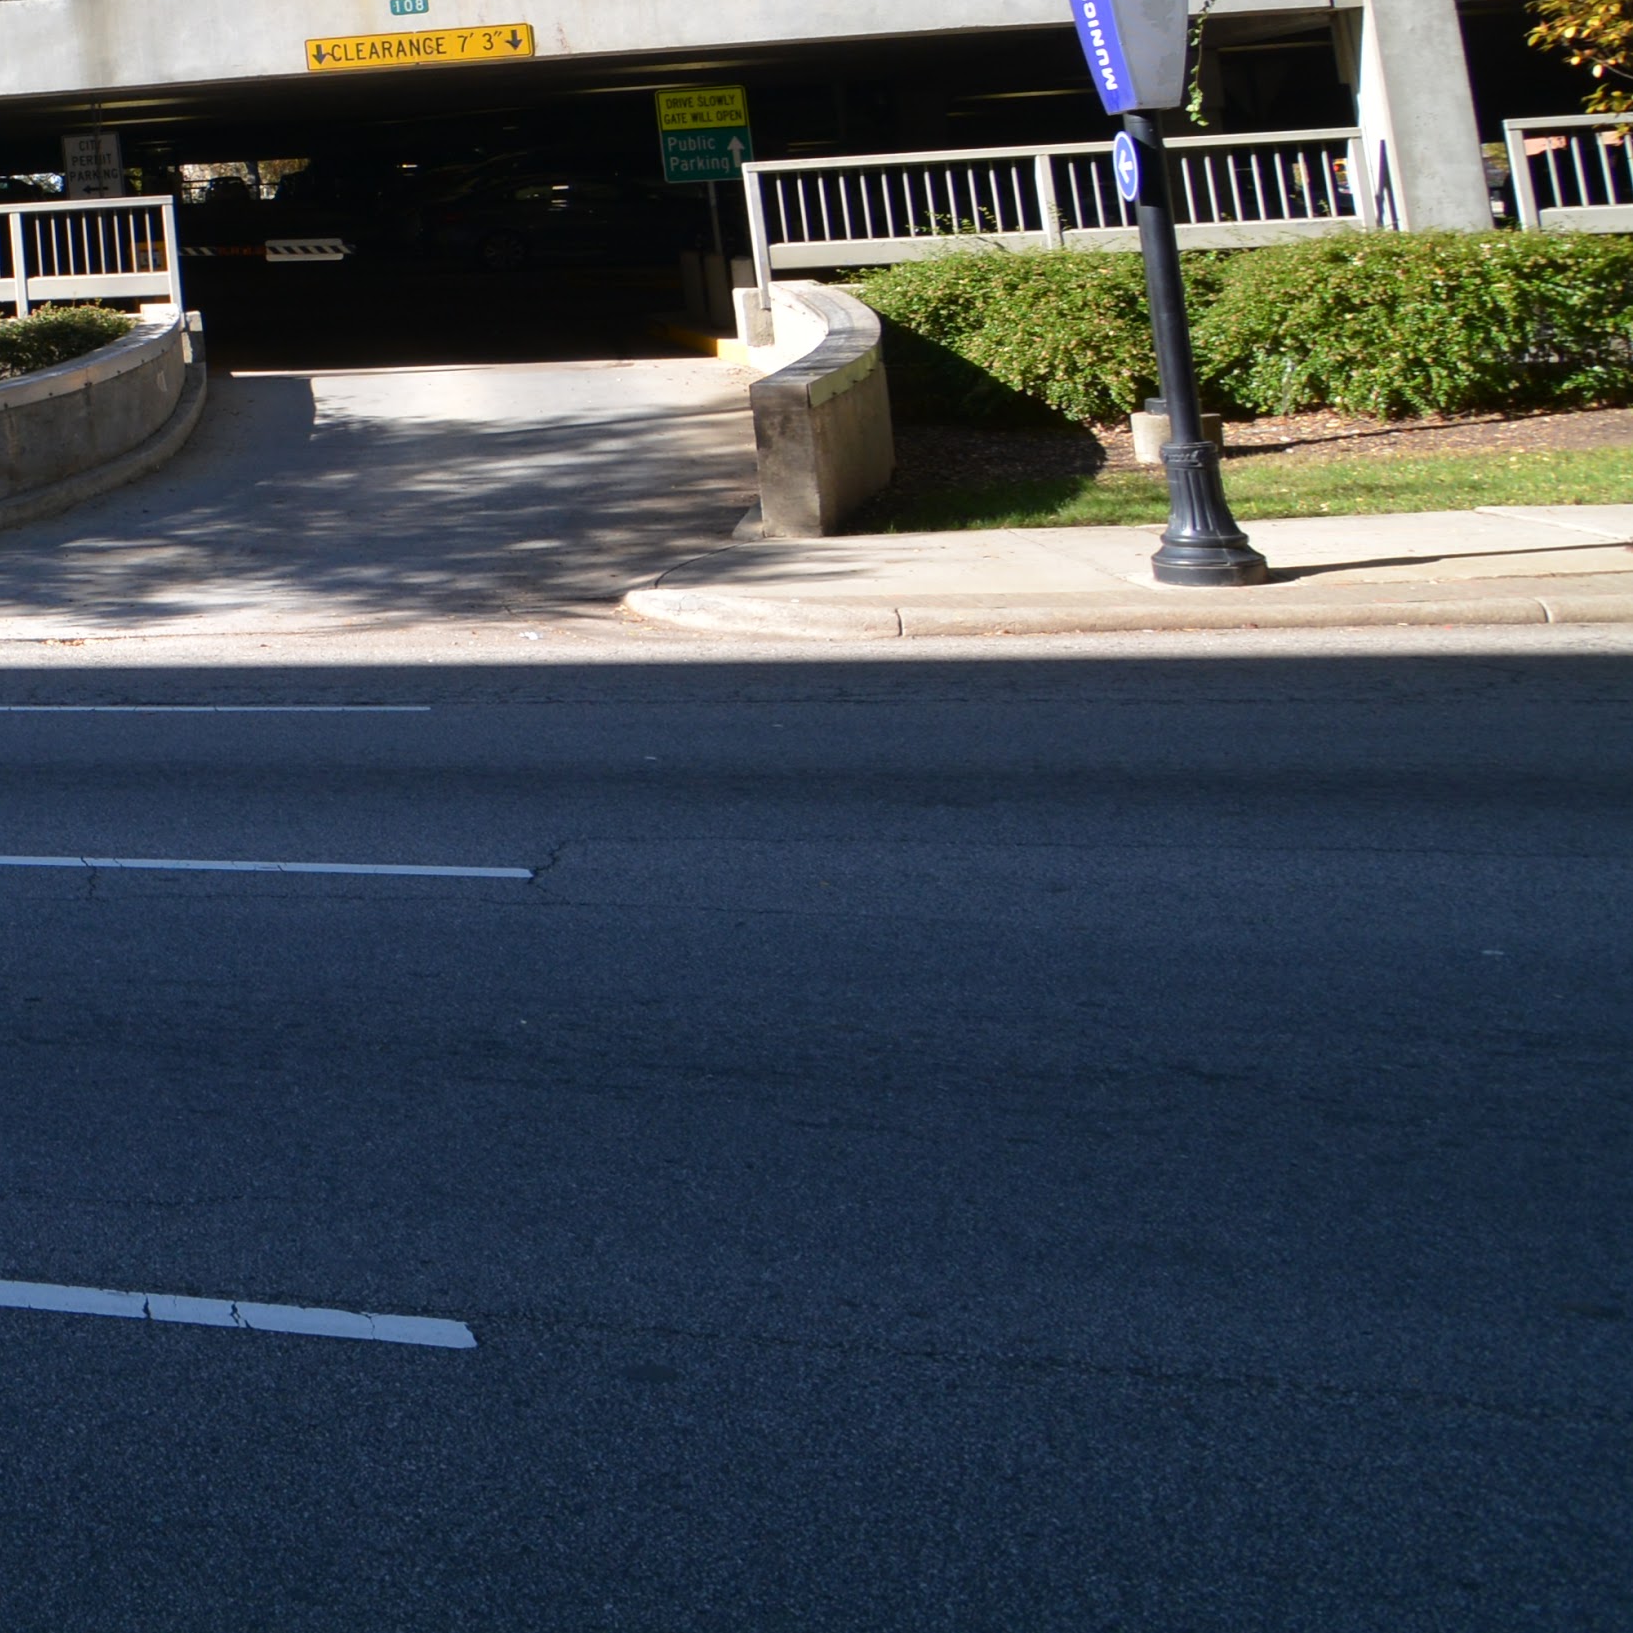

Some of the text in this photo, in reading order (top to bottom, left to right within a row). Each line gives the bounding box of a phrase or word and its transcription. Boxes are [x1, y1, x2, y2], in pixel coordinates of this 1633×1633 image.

[330, 36, 447, 62] CLEARANCE
[665, 94, 736, 109] DRIVE SLOWLY
[663, 109, 743, 125] GATE WILL OPEN
[667, 135, 716, 152] Public
[670, 156, 730, 173] Parking
[69, 167, 119, 182] PARKNG
